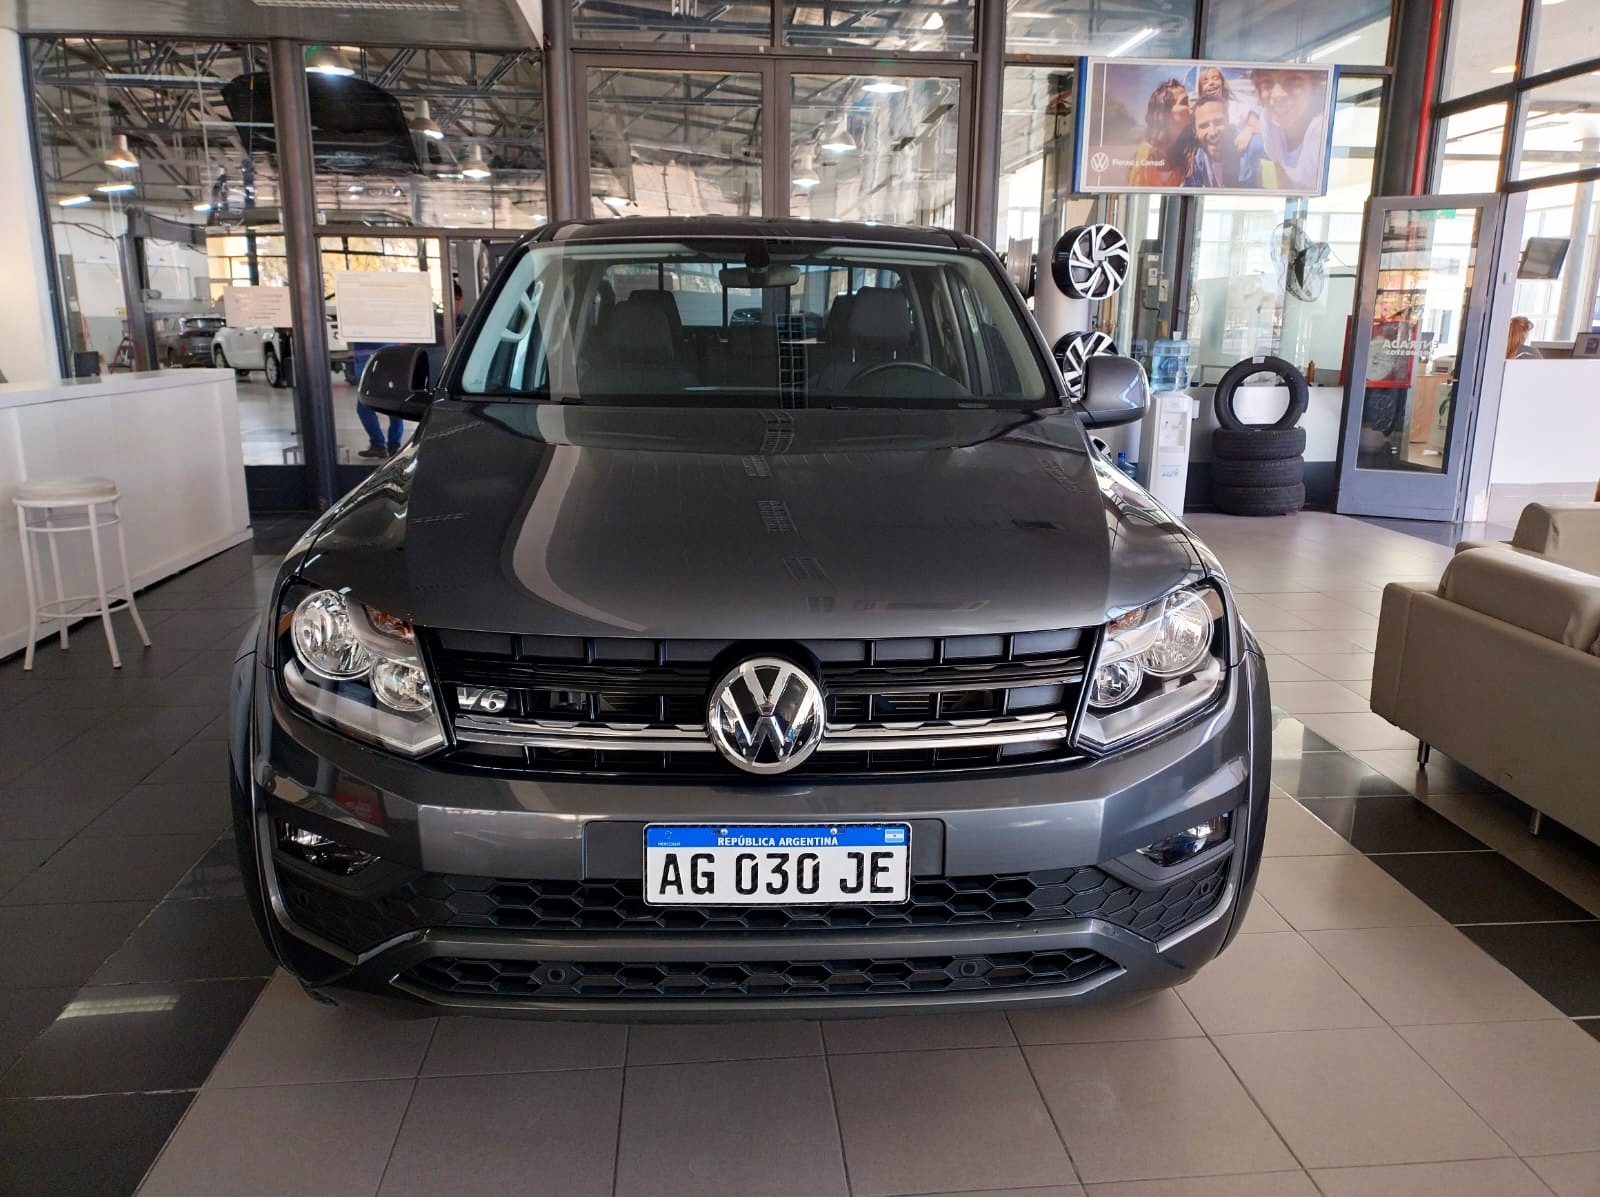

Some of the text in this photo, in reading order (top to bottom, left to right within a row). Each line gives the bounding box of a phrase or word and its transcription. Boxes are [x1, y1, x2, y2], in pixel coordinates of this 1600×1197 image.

[456, 687, 508, 713] V6
[717, 835, 839, 847] REPÚBLICA ARGENTINA
[659, 851, 894, 895] AG 030 JE
